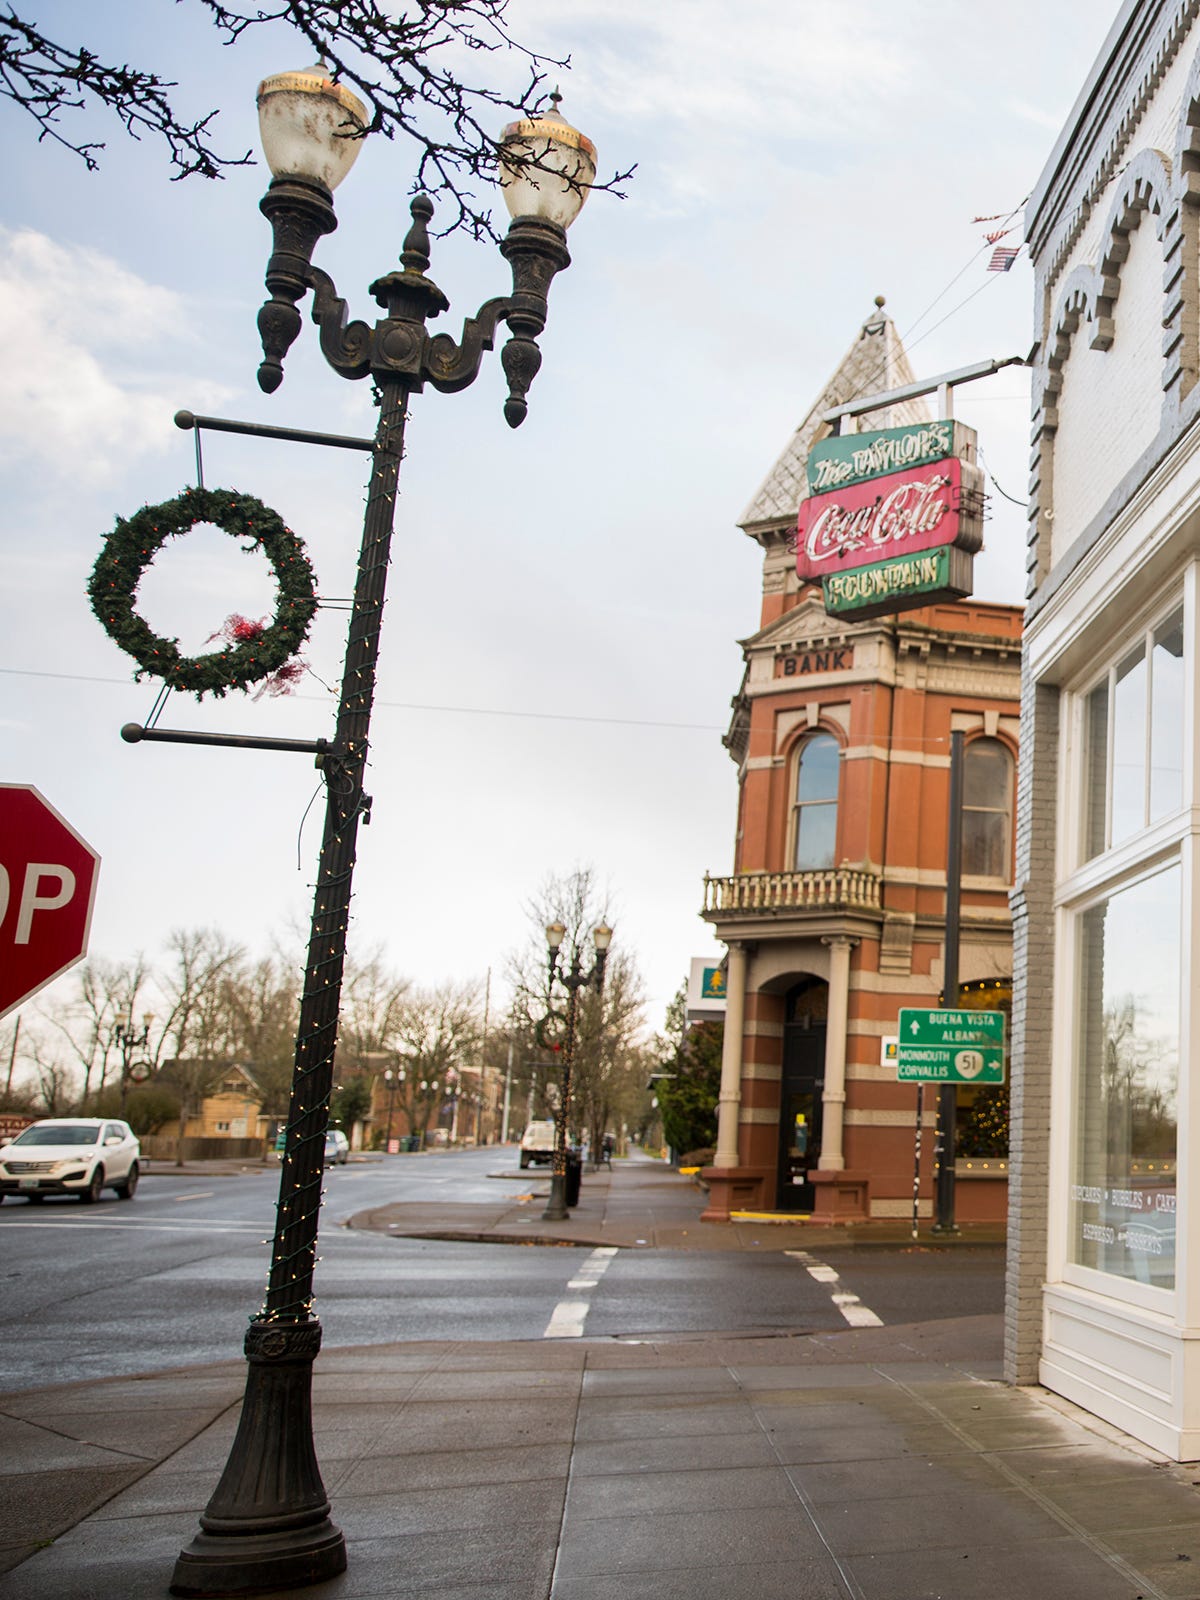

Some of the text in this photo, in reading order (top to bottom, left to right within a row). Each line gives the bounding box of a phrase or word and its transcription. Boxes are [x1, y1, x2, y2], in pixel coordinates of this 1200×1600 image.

[811, 458, 855, 487] The
[829, 556, 938, 604] FOUNTAIN
[784, 651, 846, 676] BANK
[928, 1012, 995, 1026] BUENA VISTA
[941, 1030, 983, 1042] ALBANY
[899, 1050, 950, 1062] MONMOUTH
[962, 1054, 976, 1070] 51
[899, 1065, 949, 1077] CORVALLIS
